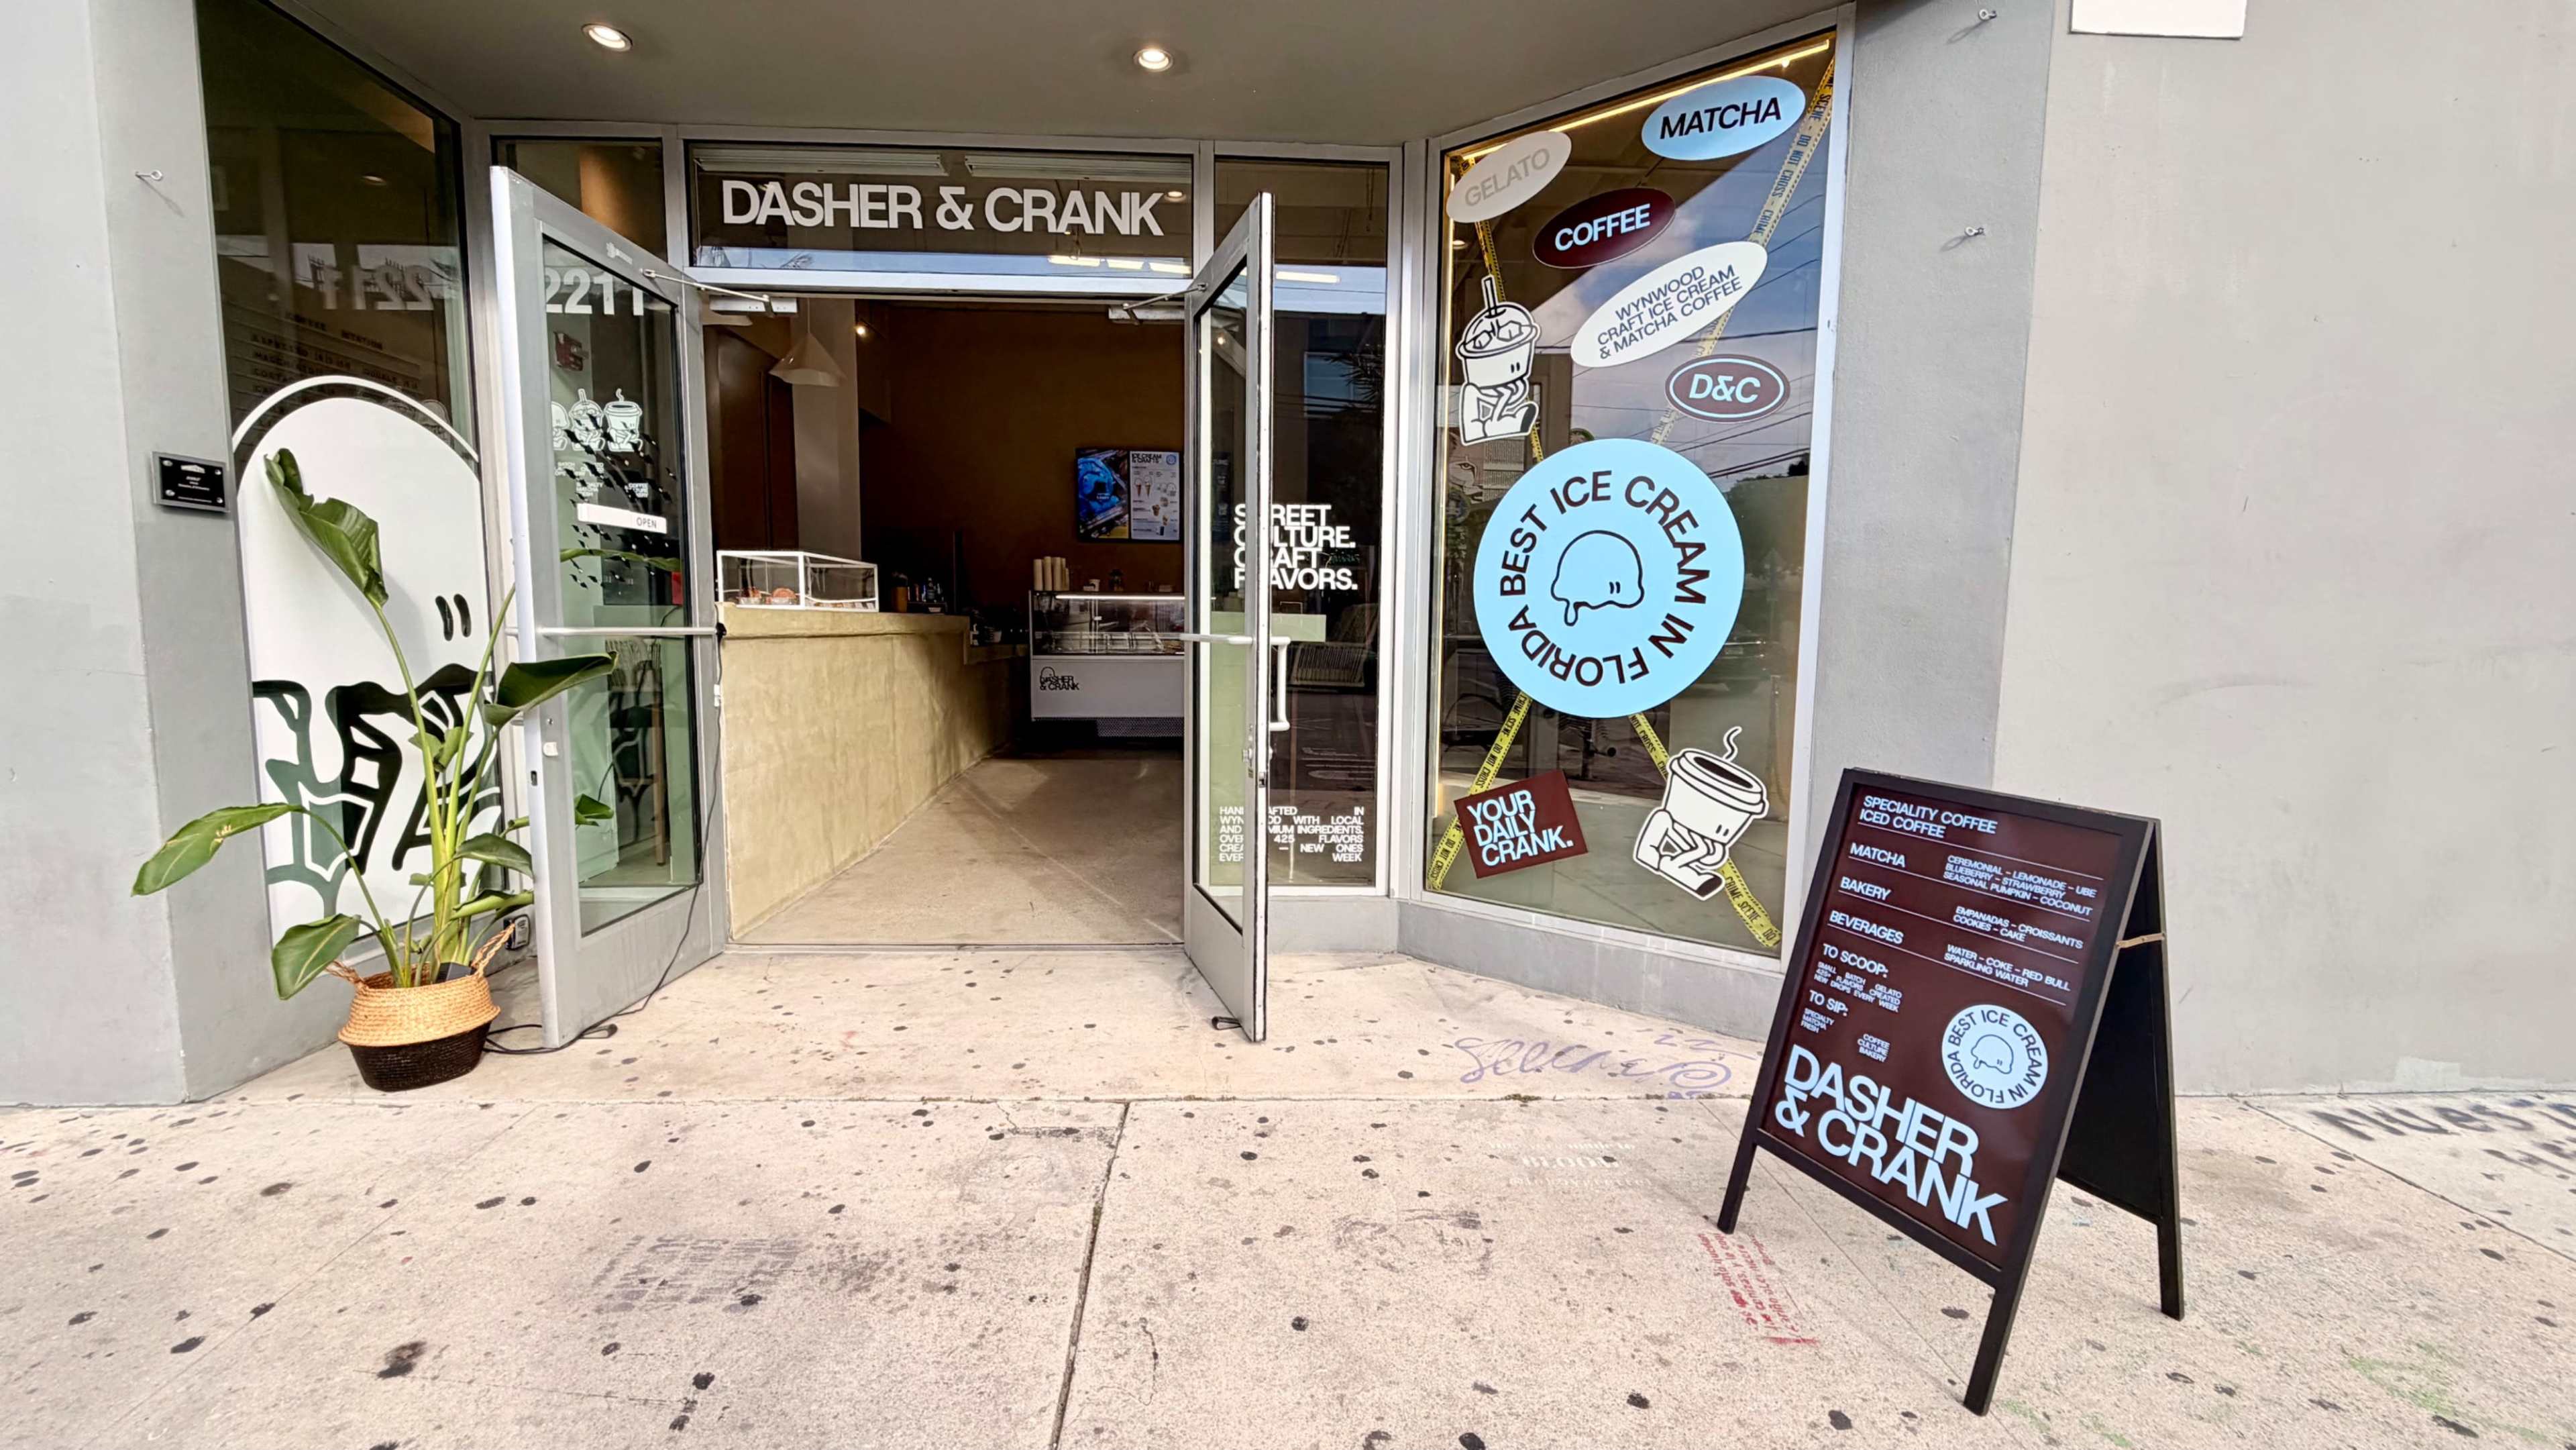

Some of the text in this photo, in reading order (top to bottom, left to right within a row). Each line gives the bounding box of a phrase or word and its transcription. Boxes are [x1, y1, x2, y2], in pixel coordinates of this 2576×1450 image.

[1659, 97, 1782, 140] MATCHA
[1787, 150, 1803, 165] NOT
[1464, 147, 1551, 207] GELATO
[1772, 170, 1794, 198] CROSS
[722, 178, 1165, 236] DASHER & CRANK
[1554, 203, 1651, 252] COFFEE
[1597, 264, 1735, 346] CRAFT ICE CREAM
[1615, 266, 1705, 321] WYNWOOD
[1599, 276, 1743, 360] & MATCHA COFFEE
[1688, 373, 1761, 403] D&C
[636, 517, 657, 529] OPEN
[1234, 503, 1332, 526] SREET
[1234, 525, 1356, 548] CLTURE.
[1234, 547, 1322, 569] CAFT
[1234, 568, 1358, 590] FAVORS.
[1499, 470, 1711, 687] BEST ICE CREAM IN FLORIDA
[1049, 682, 1079, 690] CRANK
[1502, 717, 1516, 737] SCENE
[1476, 768, 1492, 788] CROSS
[1293, 815, 1320, 825] WITH
[1331, 815, 1364, 825] LOCAL
[1354, 807, 1364, 815] IN
[1466, 789, 1536, 825] YOUR
[1860, 808, 1946, 839] ICED COFFEE
[1864, 795, 1998, 834] SPECIALITY COFFEE
[1219, 825, 1242, 834] AND
[1297, 825, 1364, 834] INGREDIENTS.
[1274, 834, 1295, 843] 425
[1318, 834, 1364, 843] FLAVORS
[1474, 811, 1536, 847] DAILY
[1481, 825, 1574, 867] CRANK.
[1299, 843, 1325, 853] NEW
[1336, 843, 1364, 853] ONES
[1332, 853, 1362, 862] WEEK
[1849, 842, 1906, 868] MATCHA
[1840, 876, 1891, 901] BAKERY
[1945, 863, 1994, 880] BLUEBERRY
[2002, 877, 2066, 900] STRAWBERRY
[1947, 854, 2004, 876] CEREMONIAL
[2012, 870, 2068, 890] LEMONADE
[2075, 885, 2098, 898] UBE
[1725, 876, 1743, 901] CRIME
[1737, 901, 1762, 923] SCENE
[1943, 871, 1988, 890] SEASONAL
[1990, 882, 2032, 900] PUMPKIN
[2040, 896, 2094, 917] COCONUT
[1829, 910, 1904, 944] BEVERAGES
[1953, 915, 1992, 932] COOKIES
[2000, 928, 2027, 943] CAKE
[1955, 905, 2010, 928] EMPANADAS
[2018, 923, 2084, 949] CROISSANTS
[1823, 943, 1889, 978] TO SCOOP:
[1943, 952, 2029, 988] SPARKLING WATER
[1947, 943, 1978, 961] WATER
[1986, 957, 2014, 972] COKE
[2022, 968, 2043, 982] RED
[2044, 976, 2072, 992] BULL
[1814, 974, 1900, 1013] NEW DROPS EVERY WEEK
[1817, 962, 1902, 999] SMALL BATCH GELATO
[1836, 976, 1864, 991] FLAVORS
[1869, 988, 1900, 1006] CREATED
[1809, 990, 1849, 1017] TO SIP:
[1801, 1020, 1888, 1063] FRESH BAKERY
[1803, 1014, 1889, 1057] MATCHA CULTURE
[1863, 1033, 1890, 1050] COFFEE
[1947, 1009, 2043, 1104] BEST ICE CREAM IN FLORIDA
[1784, 1043, 1979, 1178] DASHER
[1775, 1084, 2009, 1247] & CRANK
